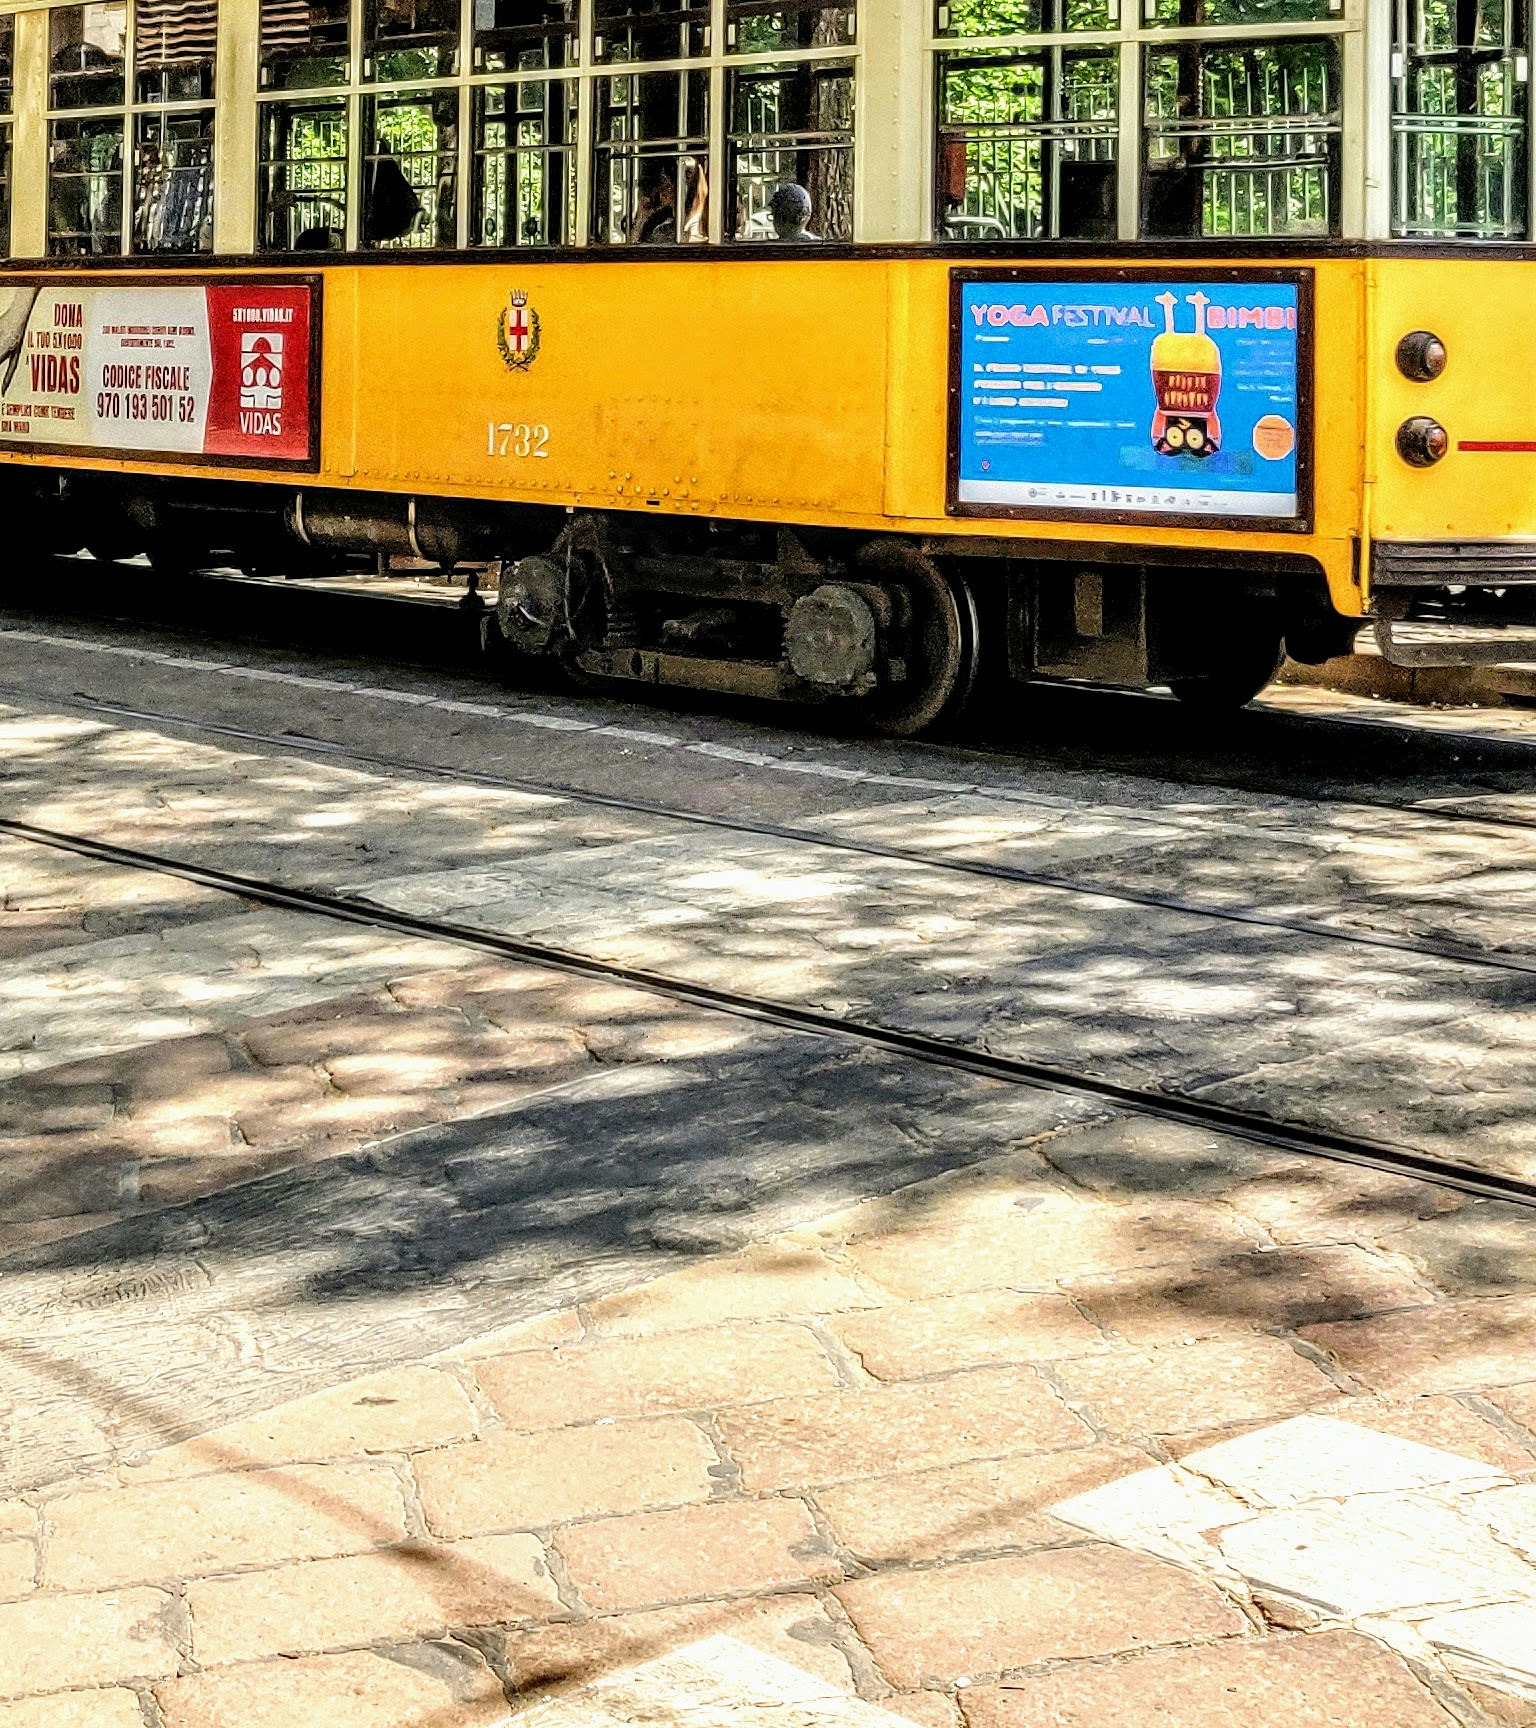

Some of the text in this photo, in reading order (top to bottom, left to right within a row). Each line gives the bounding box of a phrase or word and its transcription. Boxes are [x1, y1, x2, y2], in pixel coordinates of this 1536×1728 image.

[54, 303, 82, 327] DONA
[970, 304, 1296, 331] YOGA FESTIVAL BIMBI
[31, 353, 80, 394] VIDAS
[102, 364, 190, 391] CODICE FISCALE
[97, 392, 195, 423] 970 193 501 52
[240, 411, 281, 436] VIDAS
[487, 422, 550, 458] 1732
